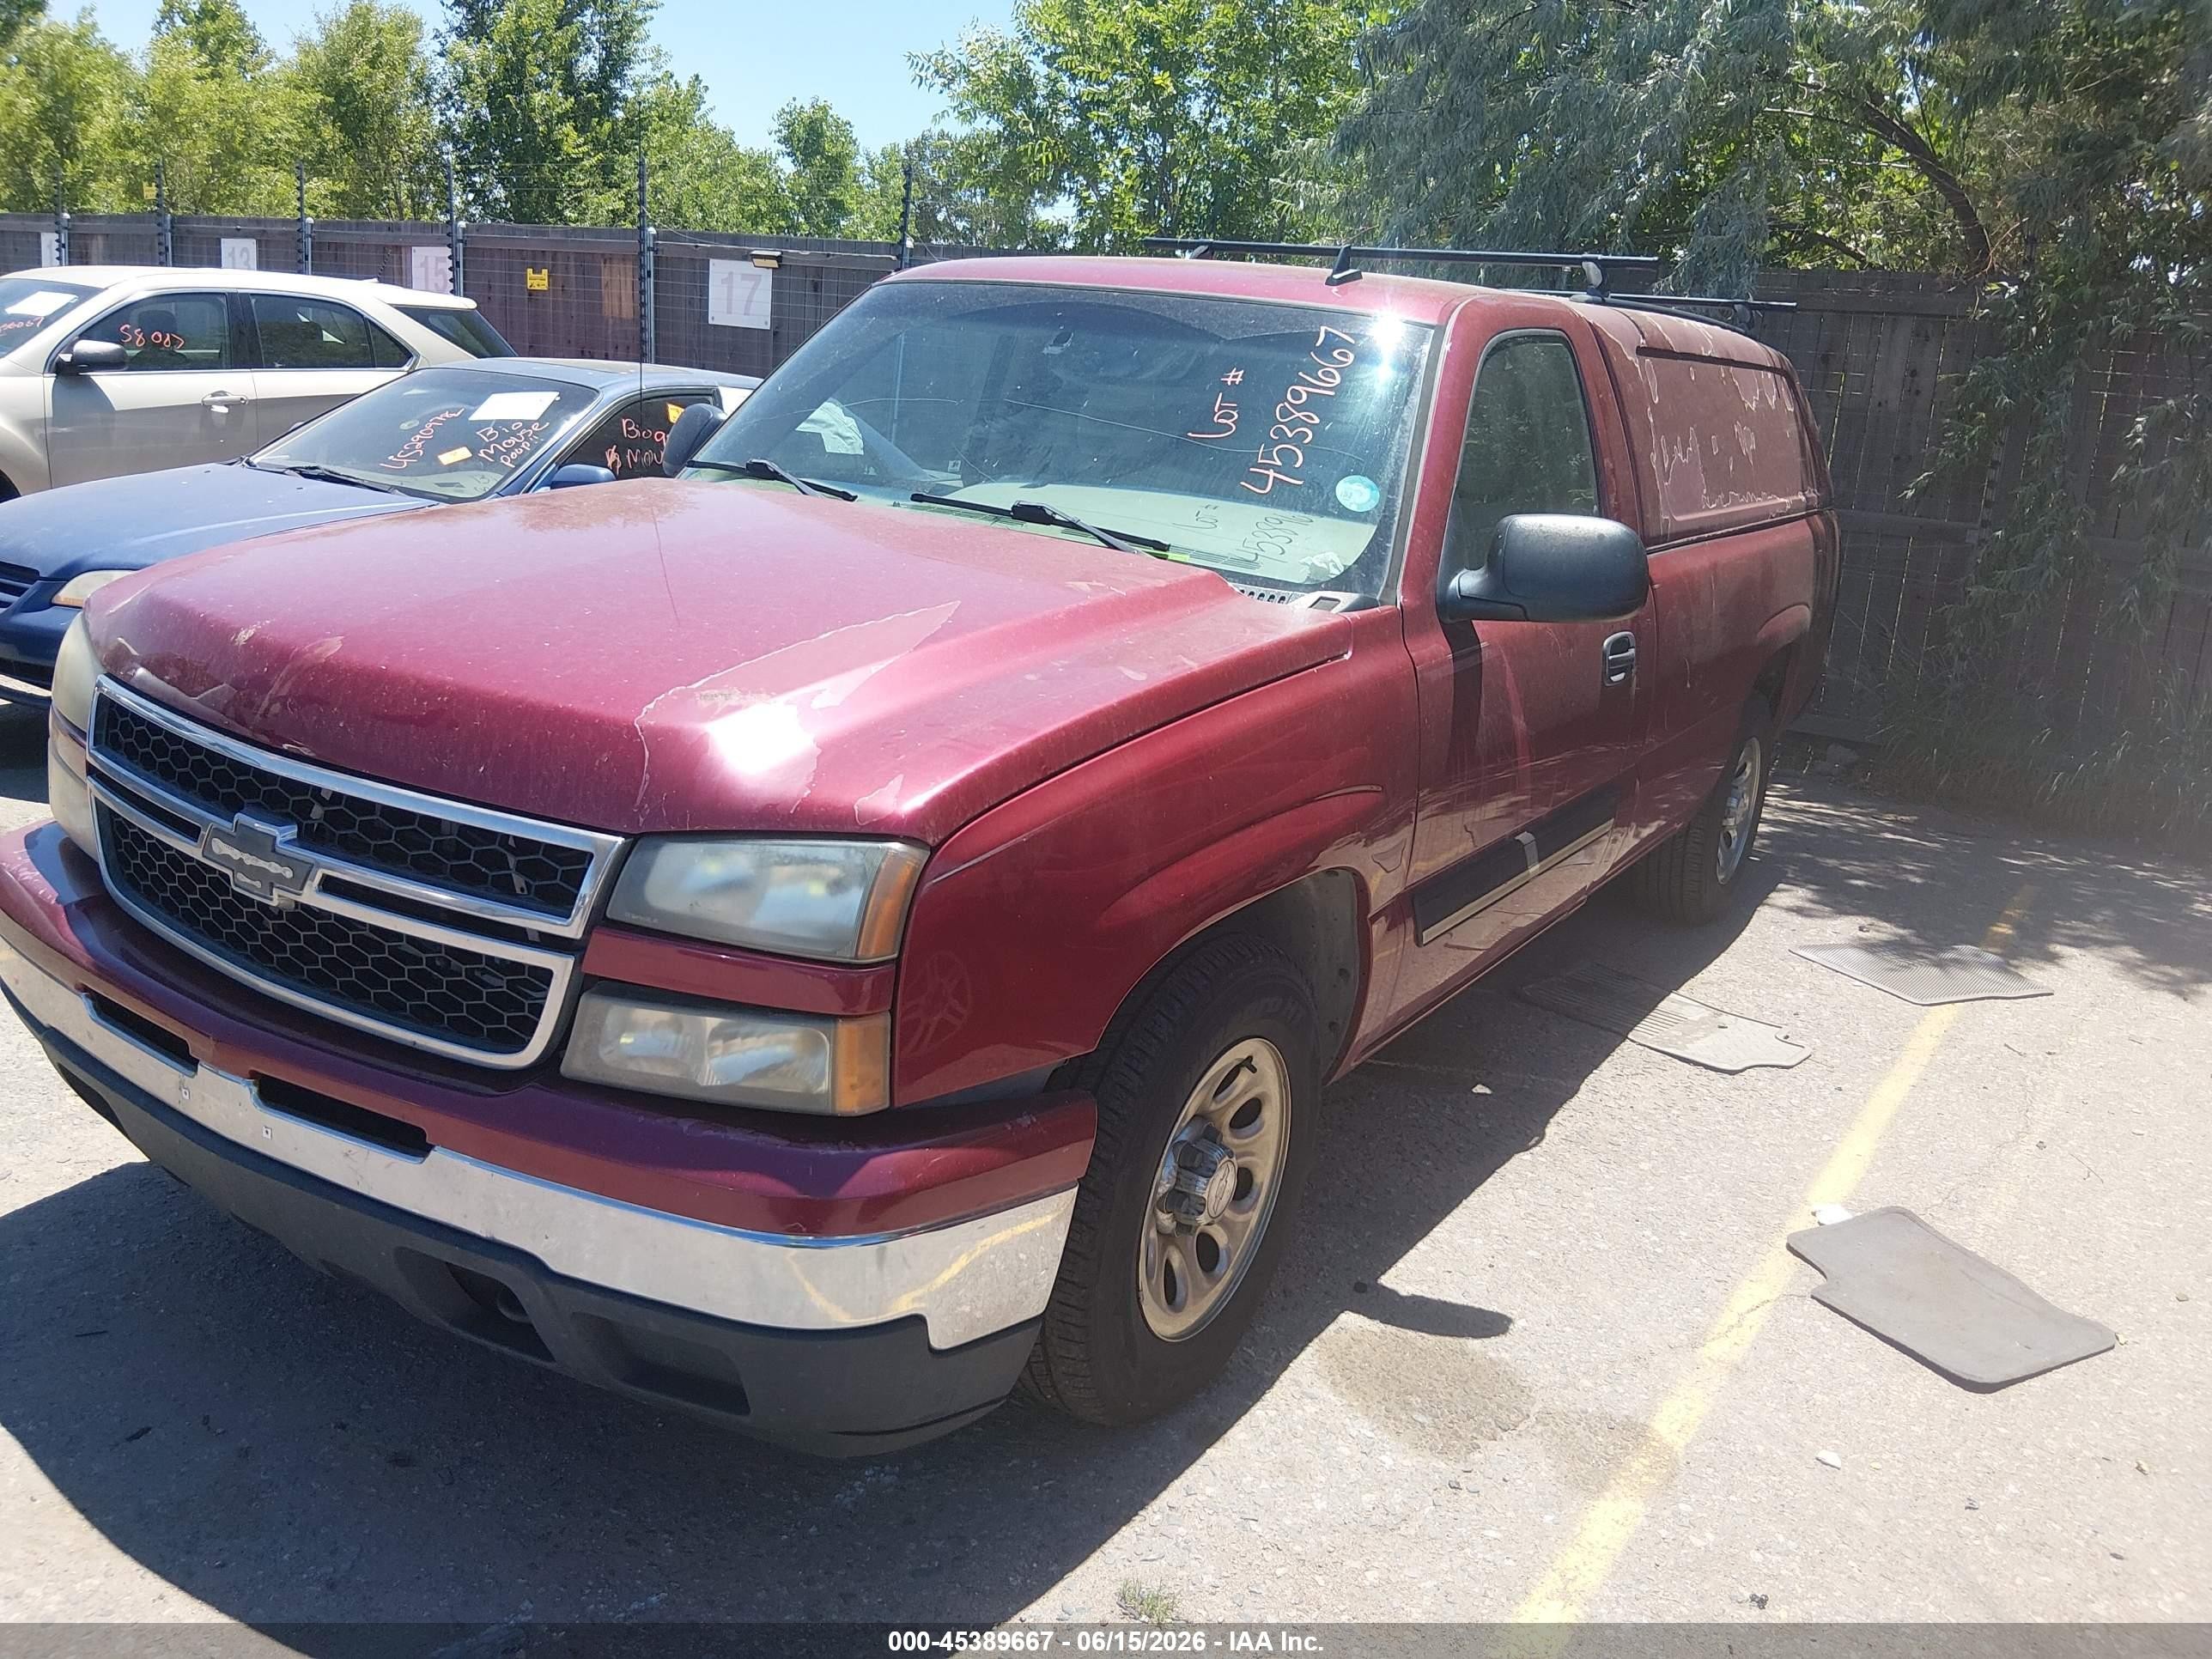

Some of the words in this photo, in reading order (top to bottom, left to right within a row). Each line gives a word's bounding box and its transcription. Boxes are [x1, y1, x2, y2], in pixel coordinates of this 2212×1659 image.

[419, 255, 447, 291] 15
[720, 271, 763, 316] 17
[1220, 367, 1245, 386] #
[1239, 325, 1357, 495] 45389667
[476, 422, 523, 443] Bio
